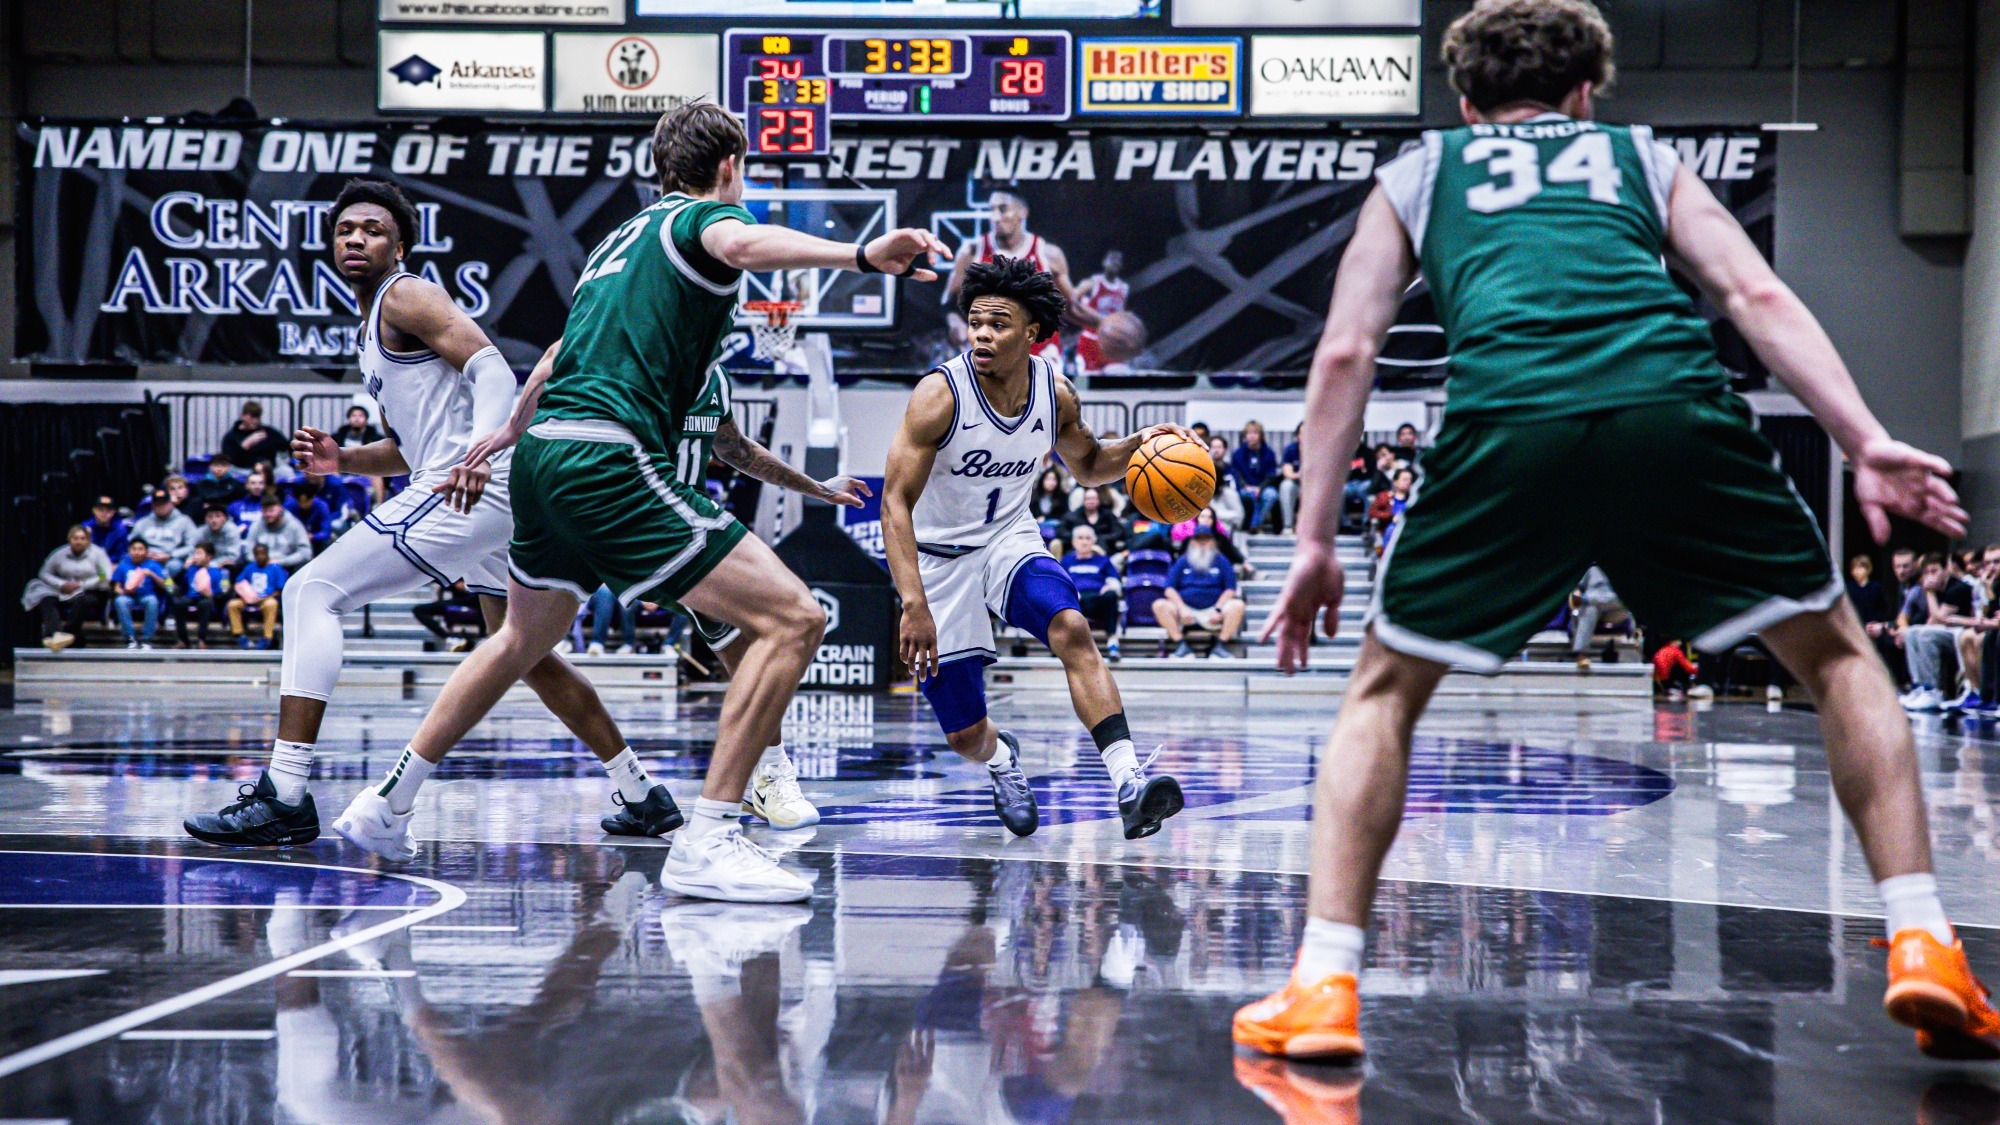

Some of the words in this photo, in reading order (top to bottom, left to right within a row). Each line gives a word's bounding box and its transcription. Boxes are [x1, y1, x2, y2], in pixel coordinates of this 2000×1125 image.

[449, 60, 536, 79] Arkansas
[865, 39, 952, 74] 3:33
[1092, 50, 1227, 75] Halter's
[1261, 56, 1412, 84] OAKLAWN
[1001, 61, 1044, 94] 28
[1091, 81, 1155, 102] BODY
[1161, 81, 1227, 102] SHOP
[760, 109, 815, 152] 23
[33, 127, 243, 171] NAMED
[258, 130, 378, 173] ONE
[391, 133, 468, 176] OF
[485, 135, 593, 176] THE
[604, 136, 658, 178] 50
[974, 139, 1095, 180] NBA
[1114, 139, 1377, 181] PLAYERS
[1655, 137, 1760, 180] ME
[1462, 131, 1621, 213] 34
[151, 191, 453, 253] CENTL
[573, 215, 651, 297] 22
[101, 246, 490, 319] ARKANS
[676, 438, 702, 486] 11
[951, 449, 1037, 478] Bears
[984, 487, 1002, 525] 1
[799, 663, 875, 686] NDAI
